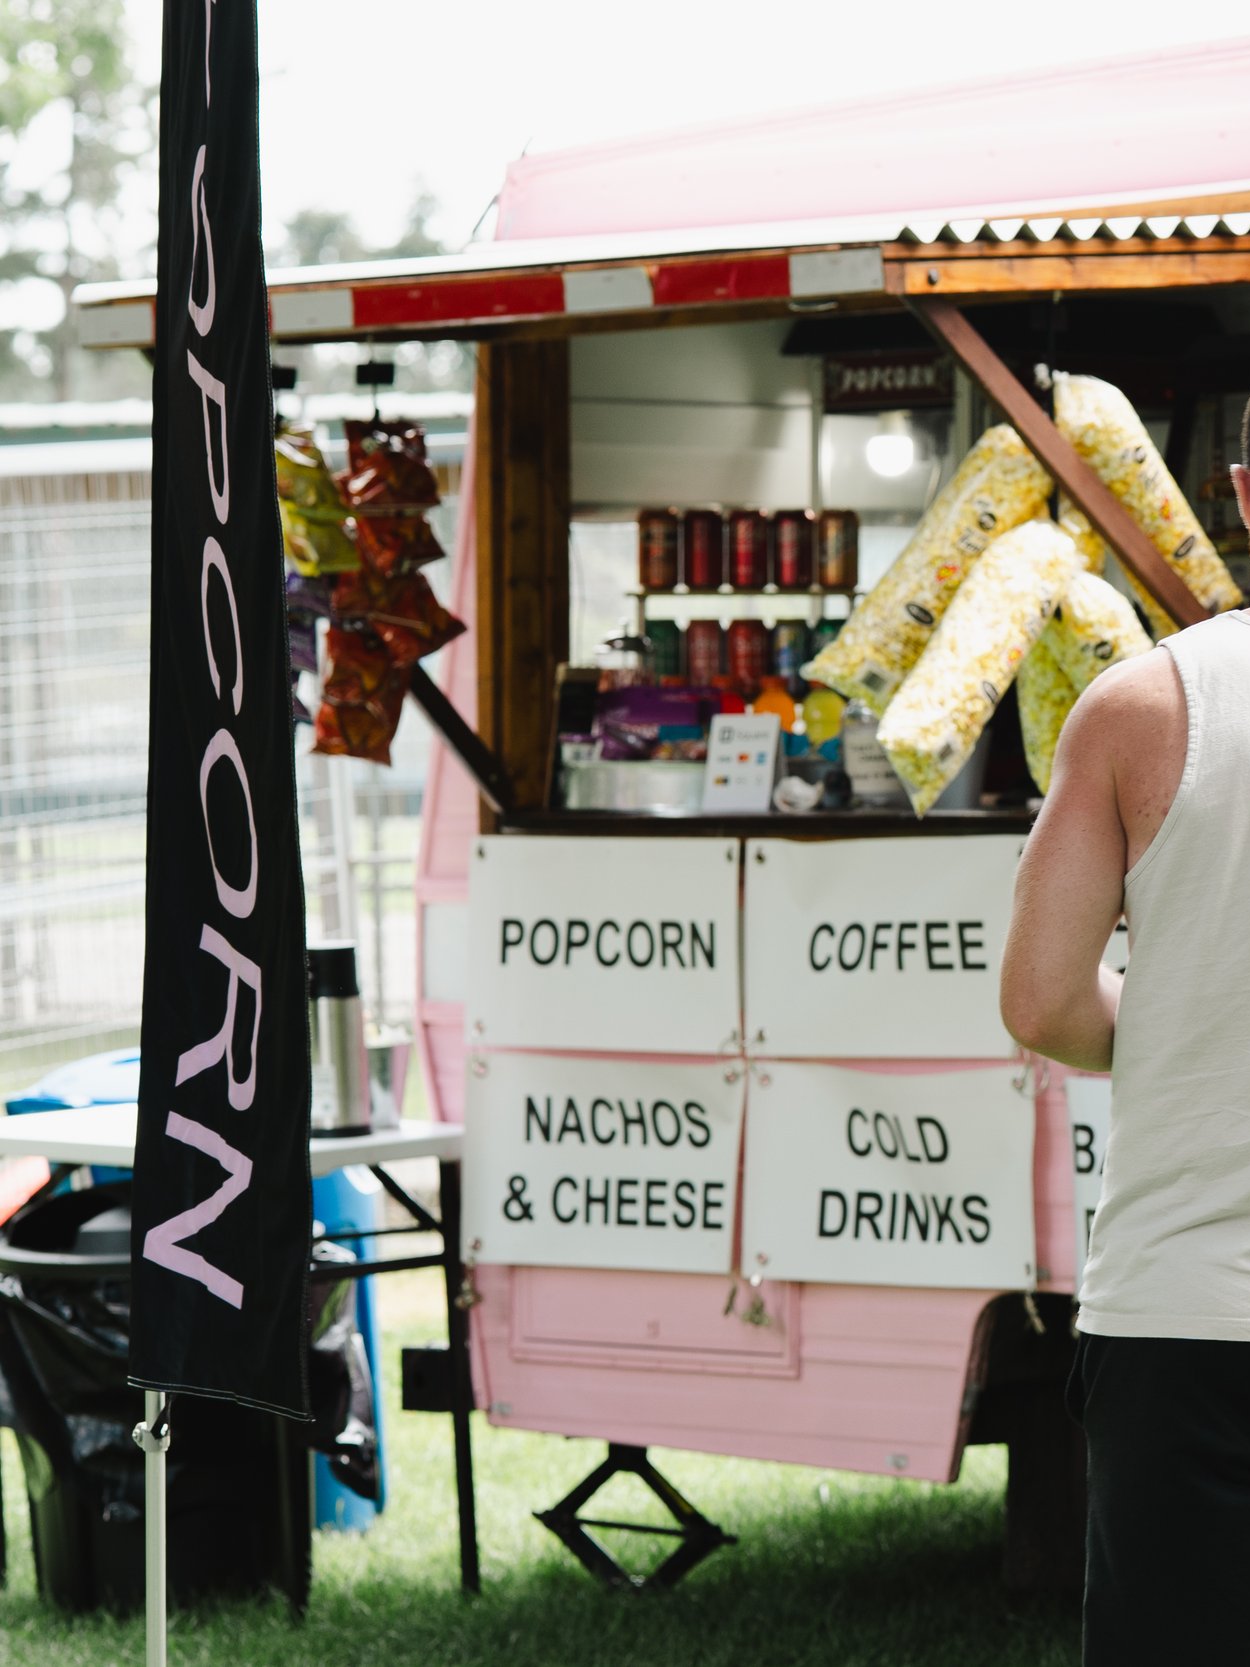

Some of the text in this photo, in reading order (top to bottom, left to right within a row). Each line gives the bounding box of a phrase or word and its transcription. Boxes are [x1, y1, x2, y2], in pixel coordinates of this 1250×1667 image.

[499, 918, 717, 969] POPCORN
[808, 920, 988, 971] COFFEE
[524, 1095, 712, 1148] NACHOS
[846, 1107, 949, 1164] COLD
[502, 1174, 726, 1230] & CHEESE
[818, 1188, 991, 1244] DRINKS
